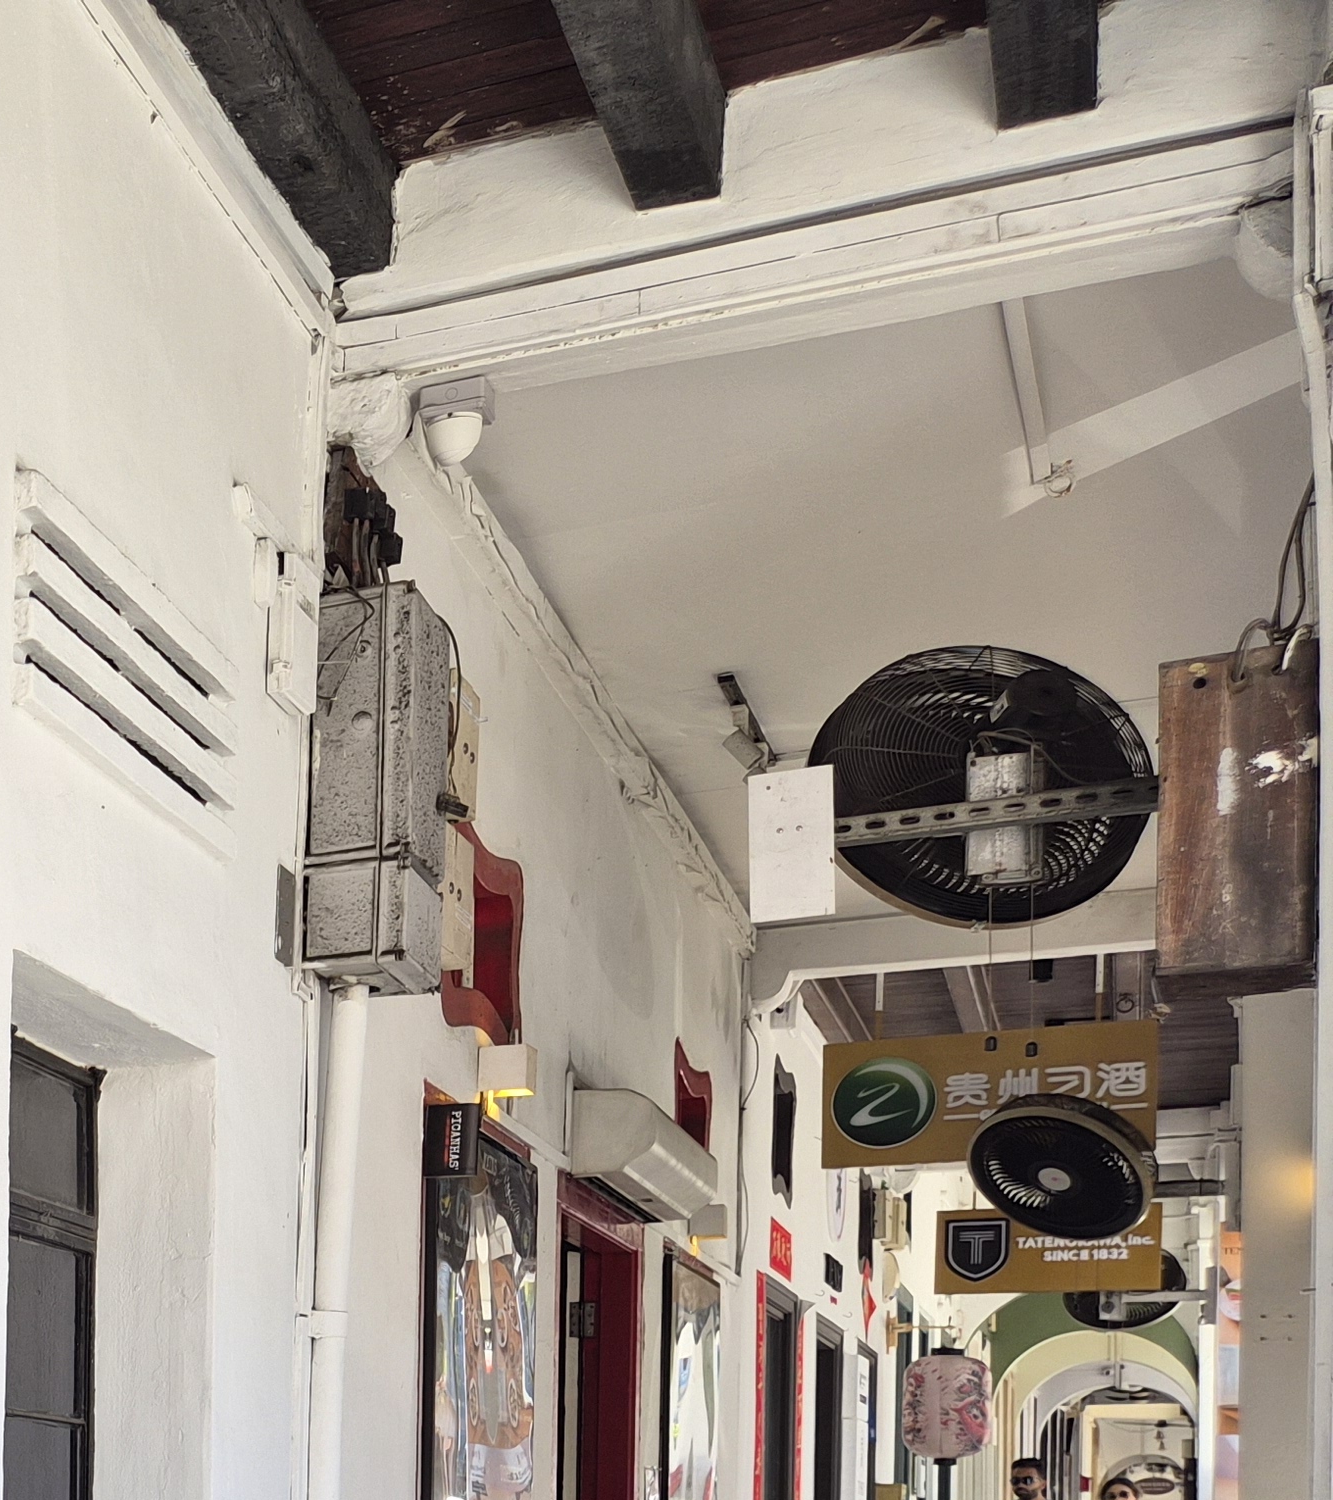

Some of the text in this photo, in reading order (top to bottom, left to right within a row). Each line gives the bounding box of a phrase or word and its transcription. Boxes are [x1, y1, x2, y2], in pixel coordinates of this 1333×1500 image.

[943, 1061, 1147, 1108] 贵州习酒
[1043, 1249, 1090, 1262] SINCE
